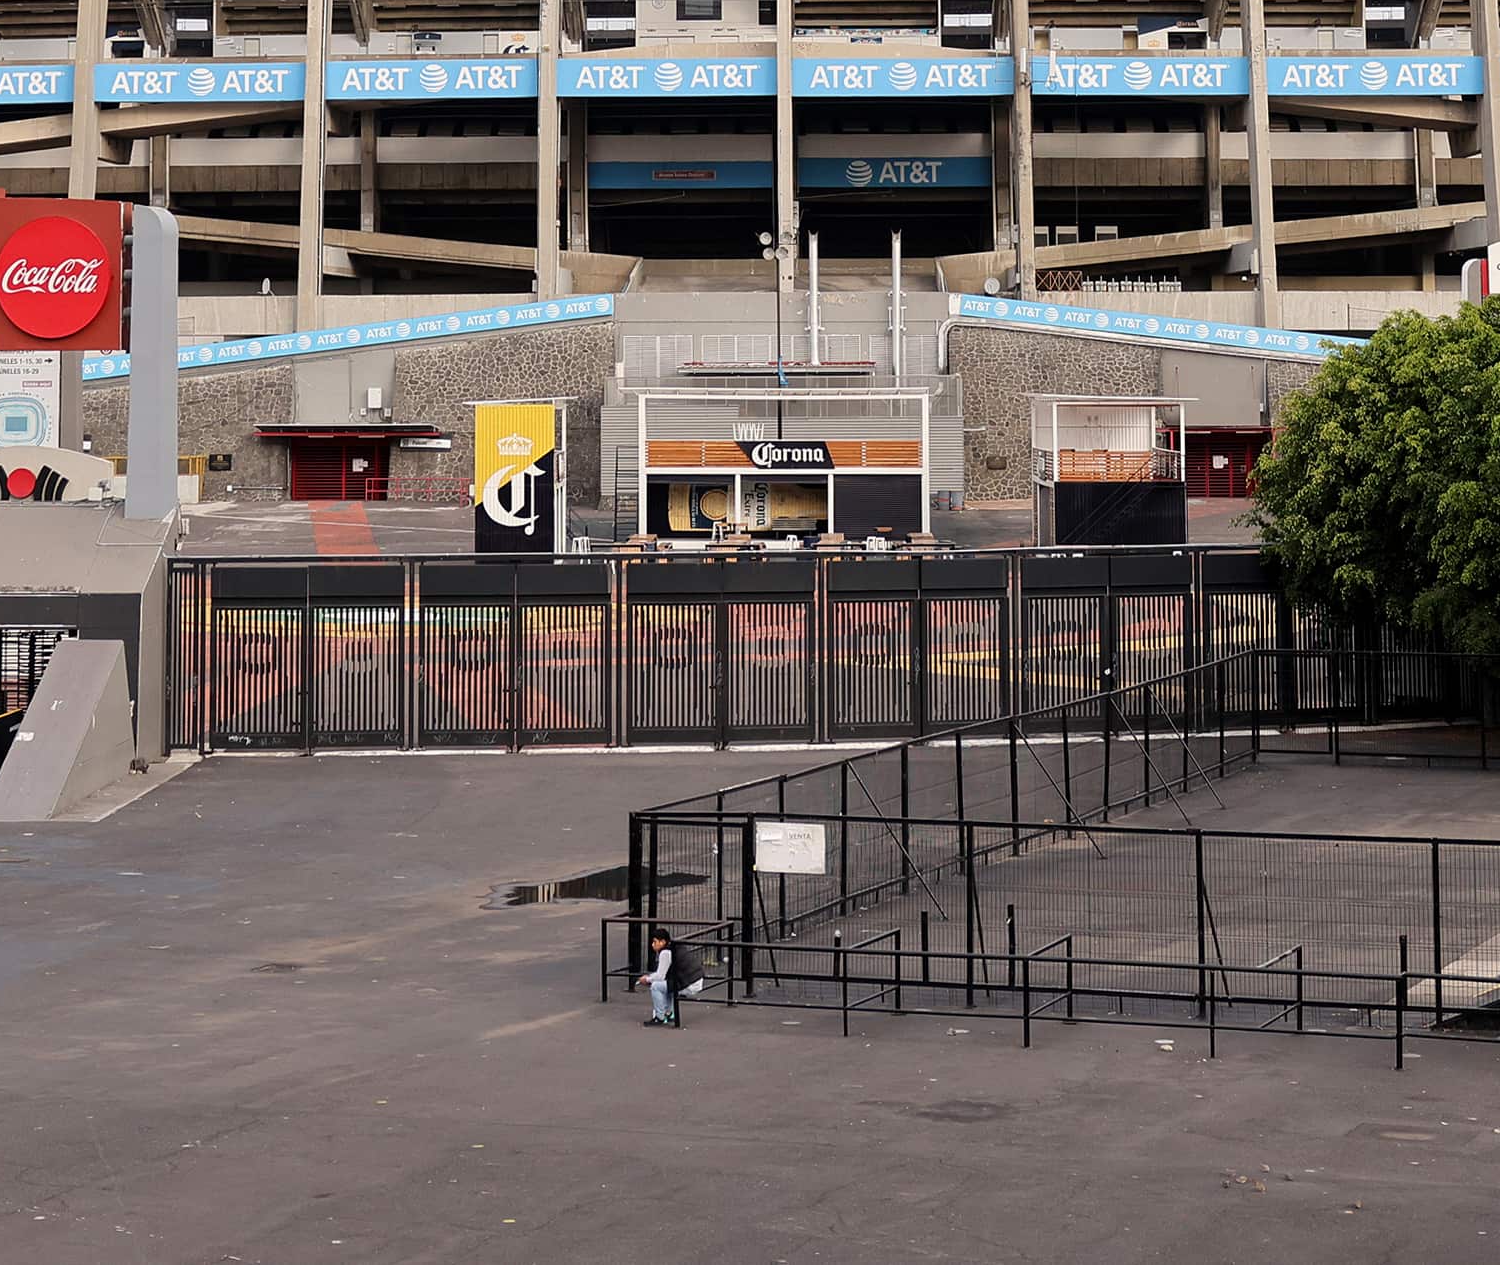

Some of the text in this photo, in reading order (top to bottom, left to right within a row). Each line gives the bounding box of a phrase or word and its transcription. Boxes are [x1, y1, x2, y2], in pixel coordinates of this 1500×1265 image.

[110, 69, 289, 95] AT&T AT&T
[342, 66, 523, 92] AT&T AT&T
[575, 64, 758, 90] AT&T AT&T
[809, 64, 992, 89] AT&T AT&T
[1046, 64, 1228, 89] AT&T AT&T
[1282, 63, 1462, 89] AT&T AT&T
[879, 161, 942, 183] AT&T
[219, 345, 245, 357] AT&T
[268, 339, 294, 352] AT&T
[318, 333, 343, 345] AT&T
[367, 326, 393, 339] AT&T
[416, 320, 443, 332] AT&T
[466, 314, 493, 326] AT&T
[516, 307, 542, 320] AT&T
[565, 301, 593, 314] AT&T
[964, 301, 1291, 347] AT&T AT&T AT&T AT&T AT&T AT&T AT&T
[751, 442, 825, 468] Corona
[755, 483, 768, 526] Corona
